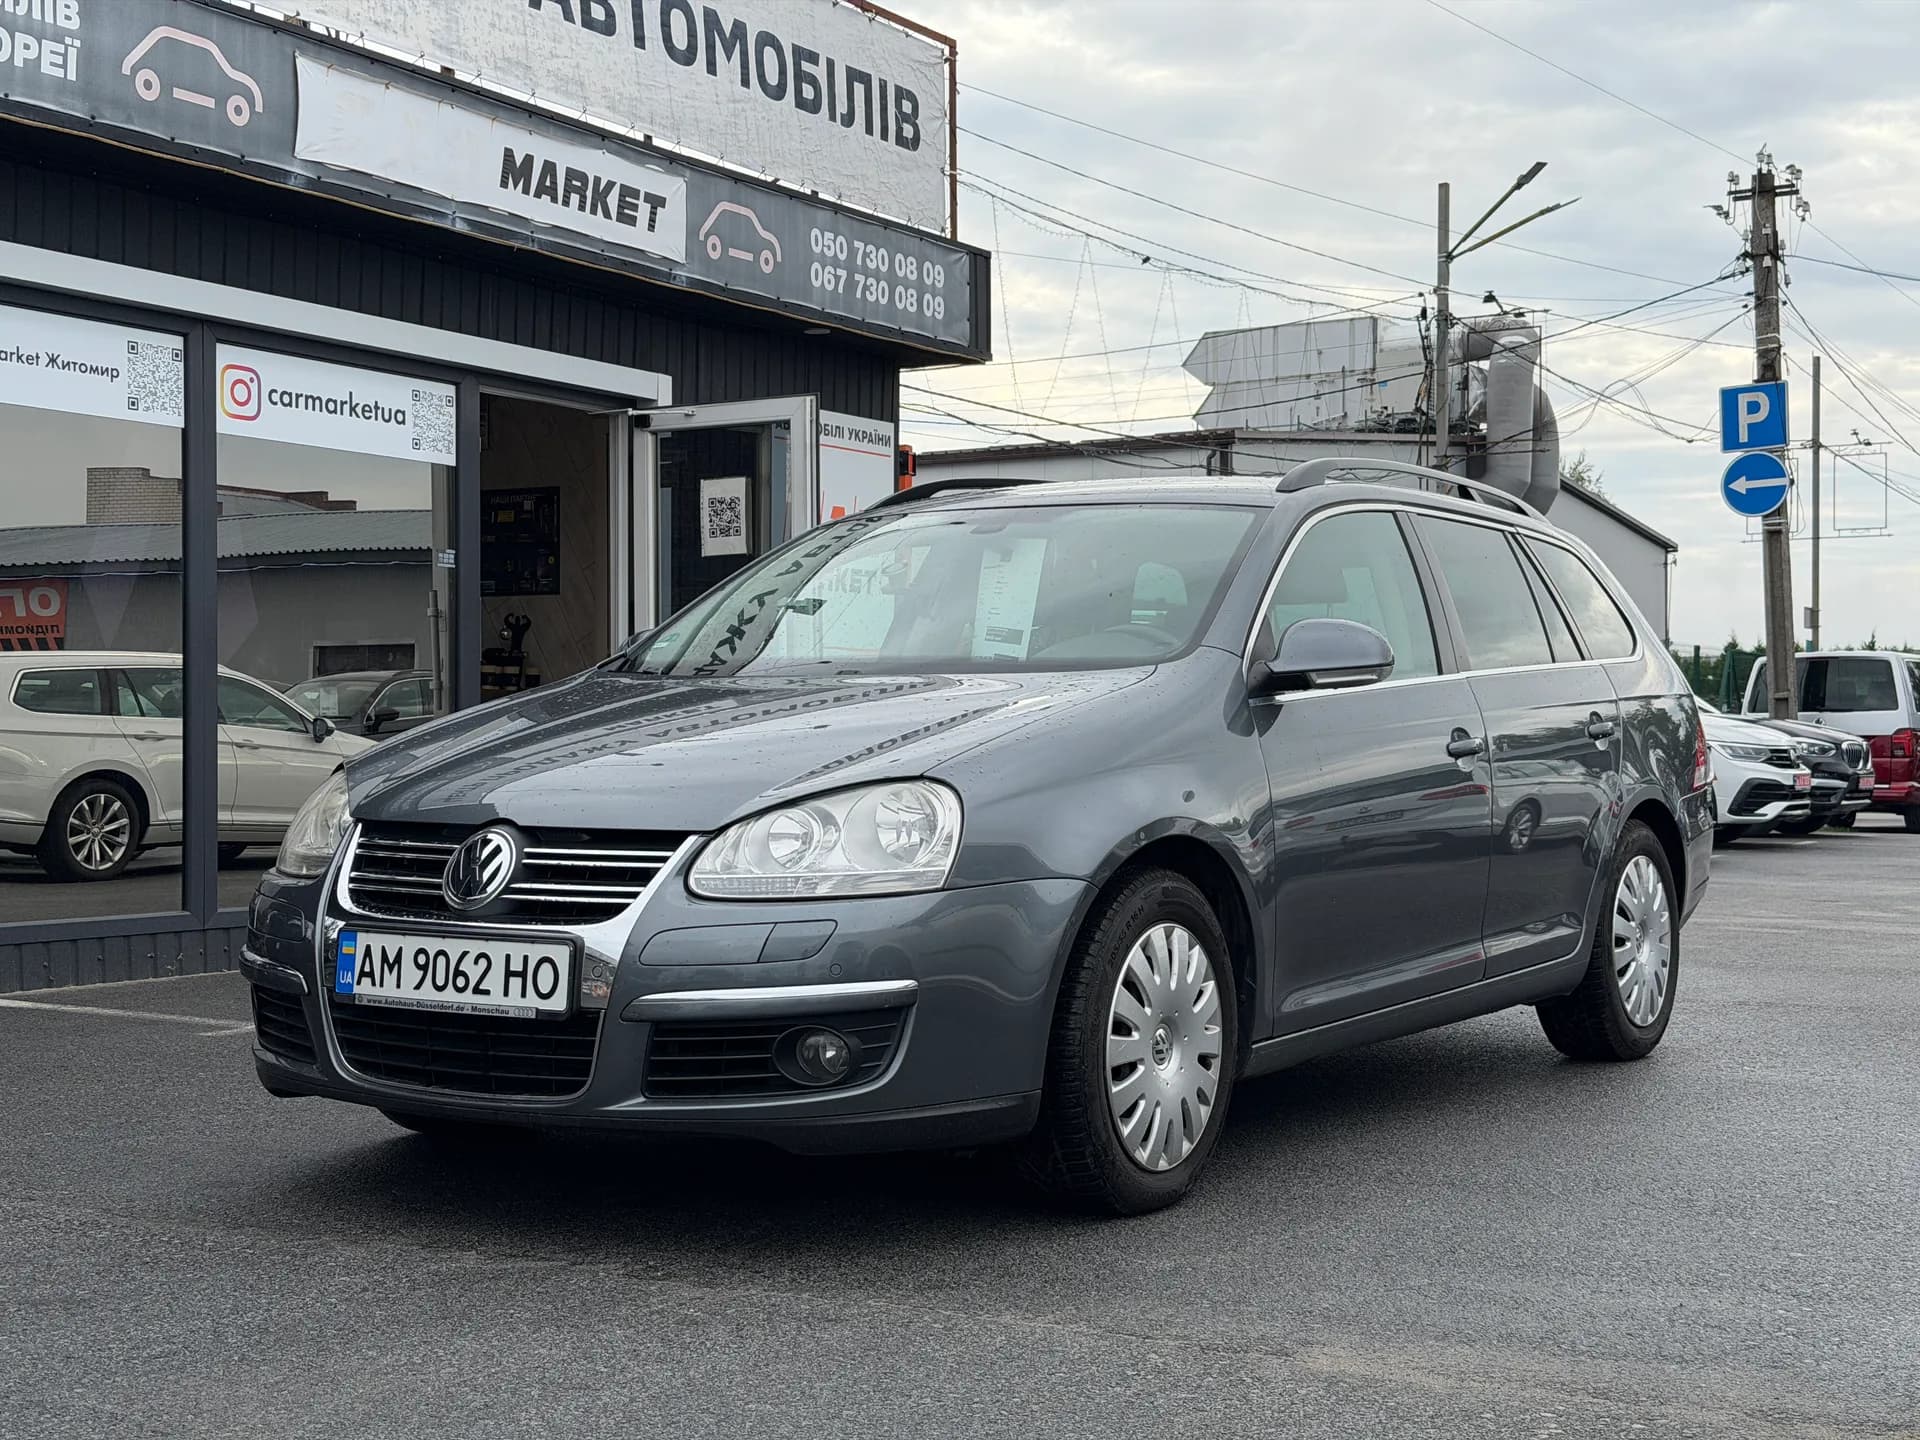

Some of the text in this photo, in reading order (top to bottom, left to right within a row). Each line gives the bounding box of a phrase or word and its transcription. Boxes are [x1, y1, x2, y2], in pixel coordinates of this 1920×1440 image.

[527, 0, 921, 153] ВТОМОБІЛІВ
[499, 146, 667, 233] MARKET
[810, 227, 945, 288] 050 730 08 09
[810, 262, 945, 320] 067 730 08 09
[44, 351, 120, 383] Житомир
[268, 390, 406, 426] carmarketua
[1737, 391, 1770, 443] P
[847, 427, 891, 448] УКРАЇНИ
[340, 970, 353, 984] UA
[356, 944, 560, 1000] AM 9062 HO
[471, 1005, 510, 1015] Monschau
